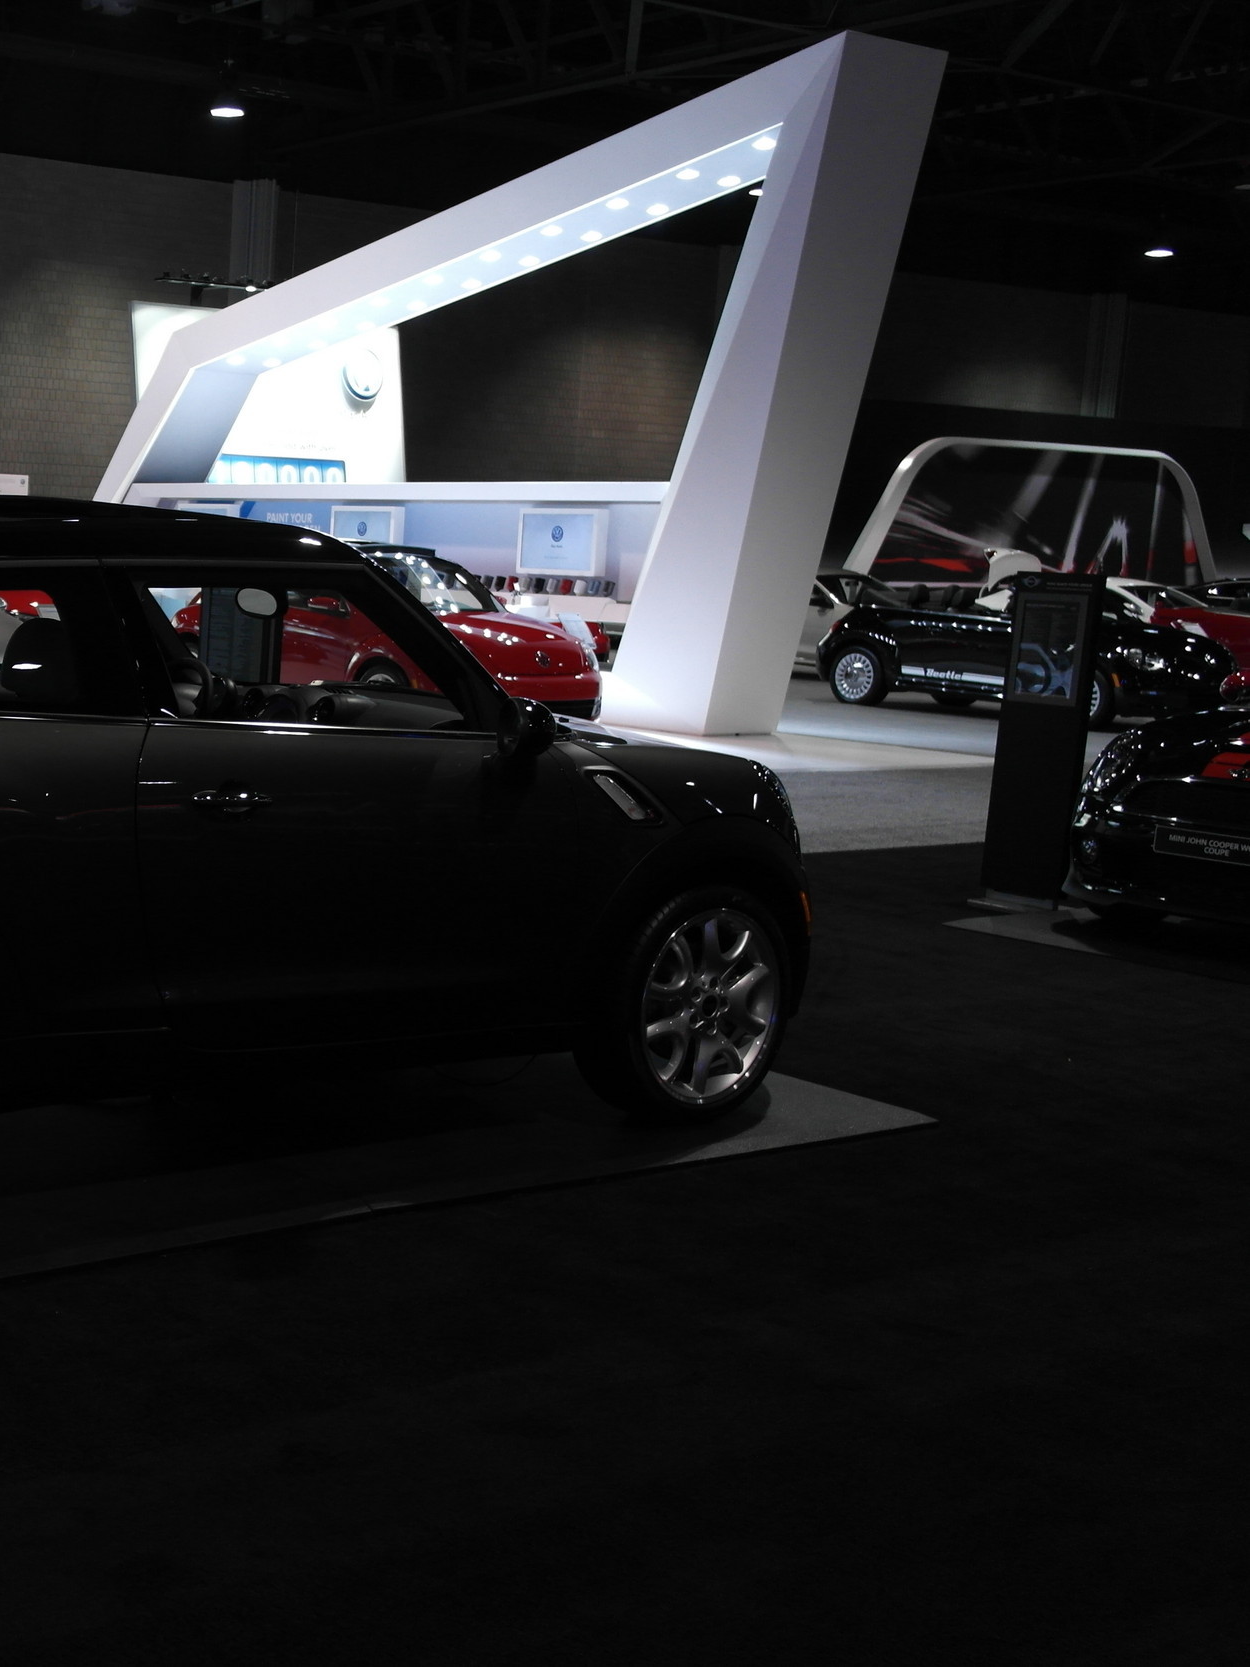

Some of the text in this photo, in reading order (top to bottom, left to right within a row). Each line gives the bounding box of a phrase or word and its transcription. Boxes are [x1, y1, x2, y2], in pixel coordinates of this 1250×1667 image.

[266, 513, 312, 524] PAINT YOUR
[926, 668, 962, 680] Beetle
[1169, 834, 1186, 843] MINI
[1186, 837, 1207, 846] JOHN
[1209, 840, 1239, 850] COOPER
[1204, 847, 1230, 857] COUPE
